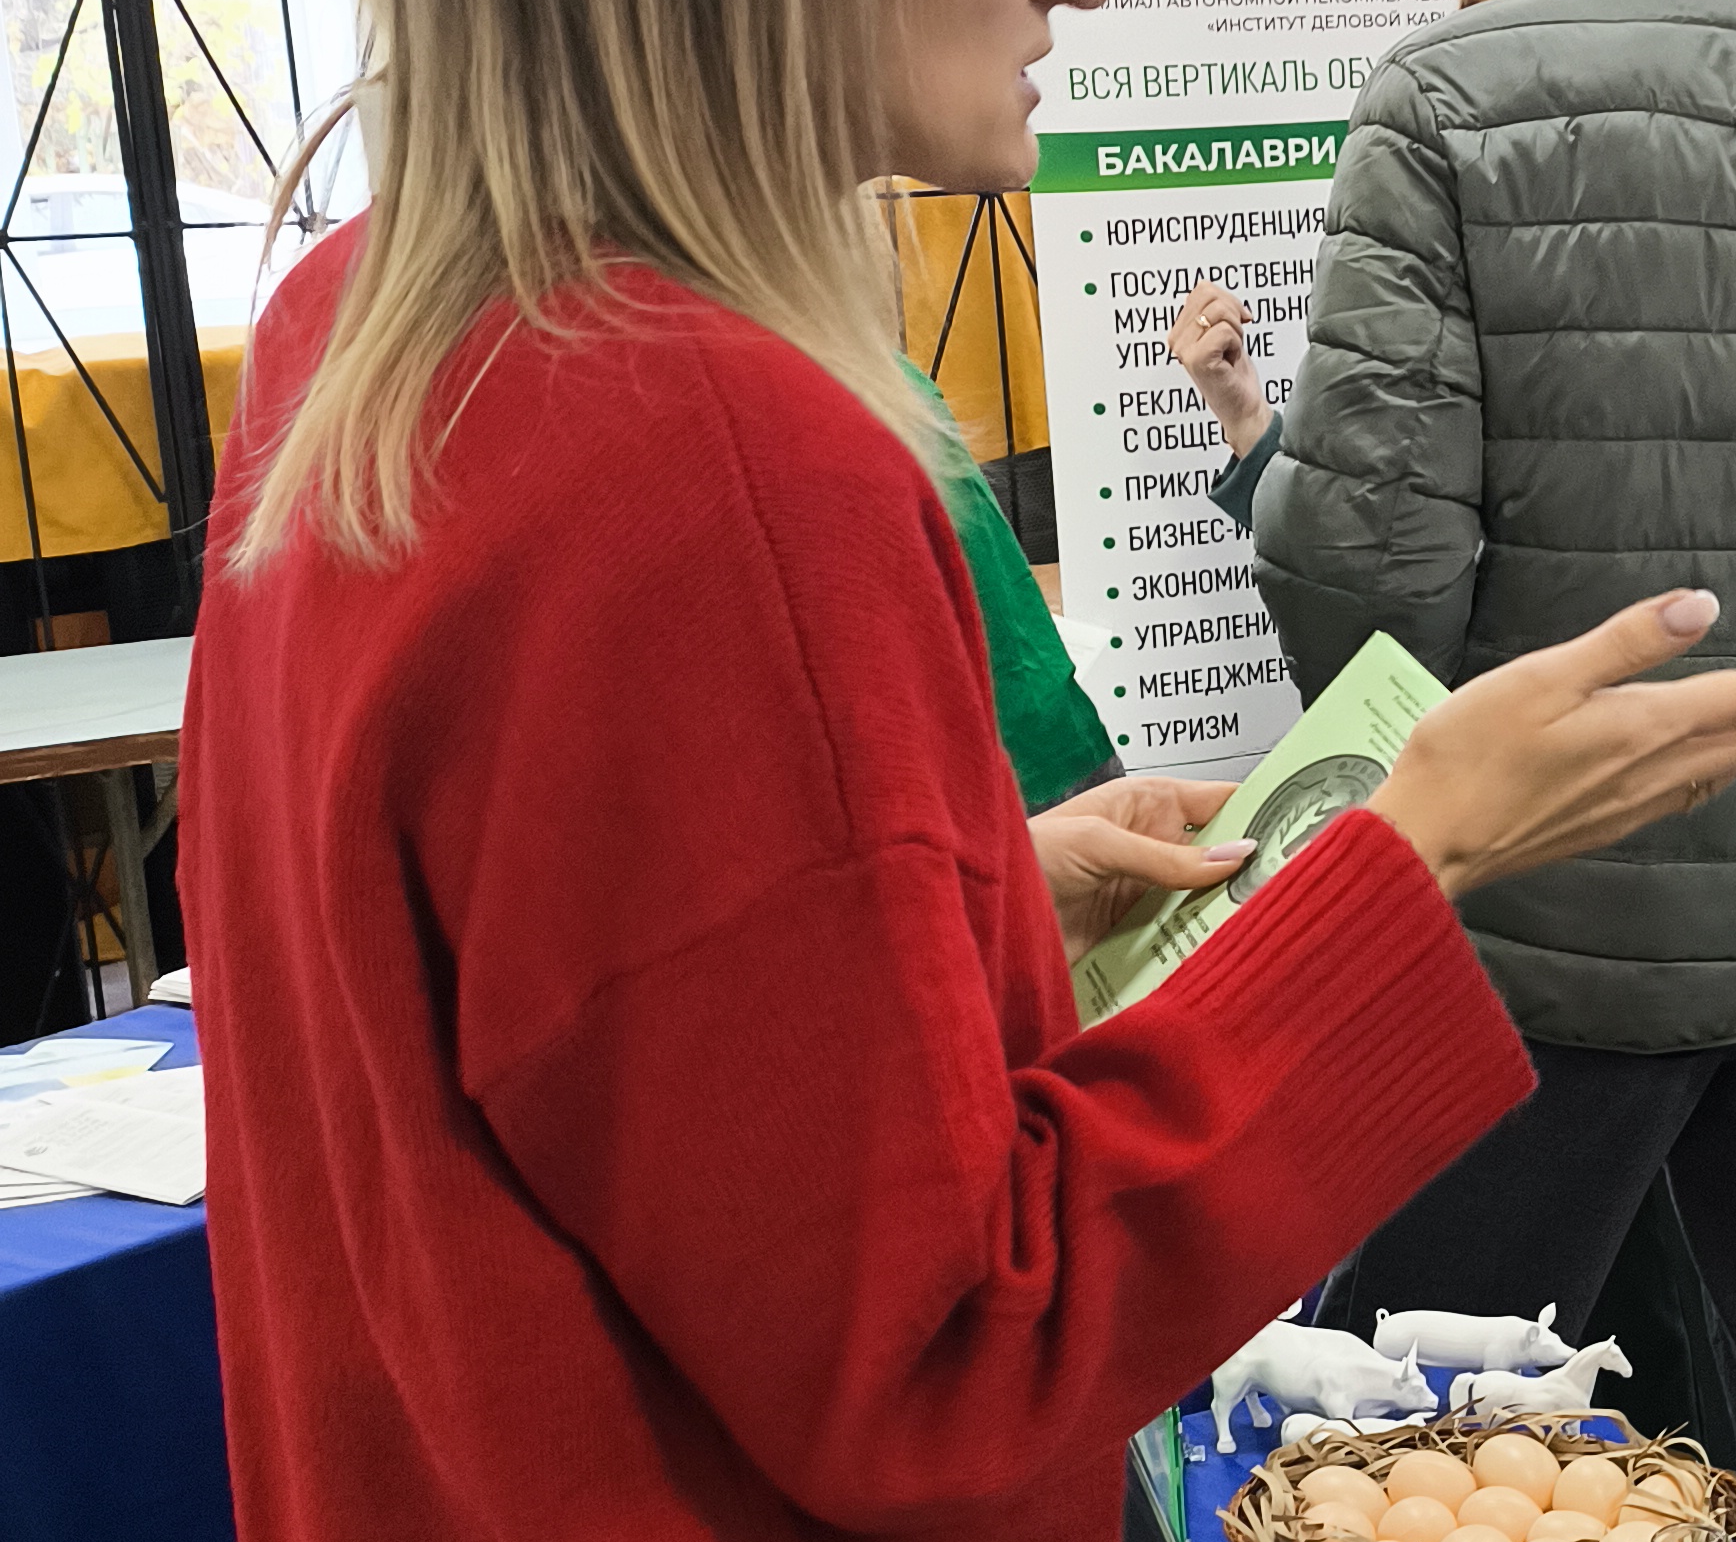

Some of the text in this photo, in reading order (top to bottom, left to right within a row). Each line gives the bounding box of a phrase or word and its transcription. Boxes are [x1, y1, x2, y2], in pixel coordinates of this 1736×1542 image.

[1207, 14, 1306, 33] «ИНСТИТУТ
[1311, 11, 1401, 32] ДЕЛОВОЙ
[1069, 66, 1133, 101] ВСЯ
[1143, 59, 1318, 99] ВЕРТИКАЛЬ
[1097, 134, 1337, 177] БАКАЛАВРИ
[1106, 207, 1326, 246] ЮРИСПРУДЕНЦИЯ
[1119, 386, 1207, 418] РЕКЛА
[1123, 427, 1139, 453] С
[1141, 712, 1240, 747] ТУРИЗМ
